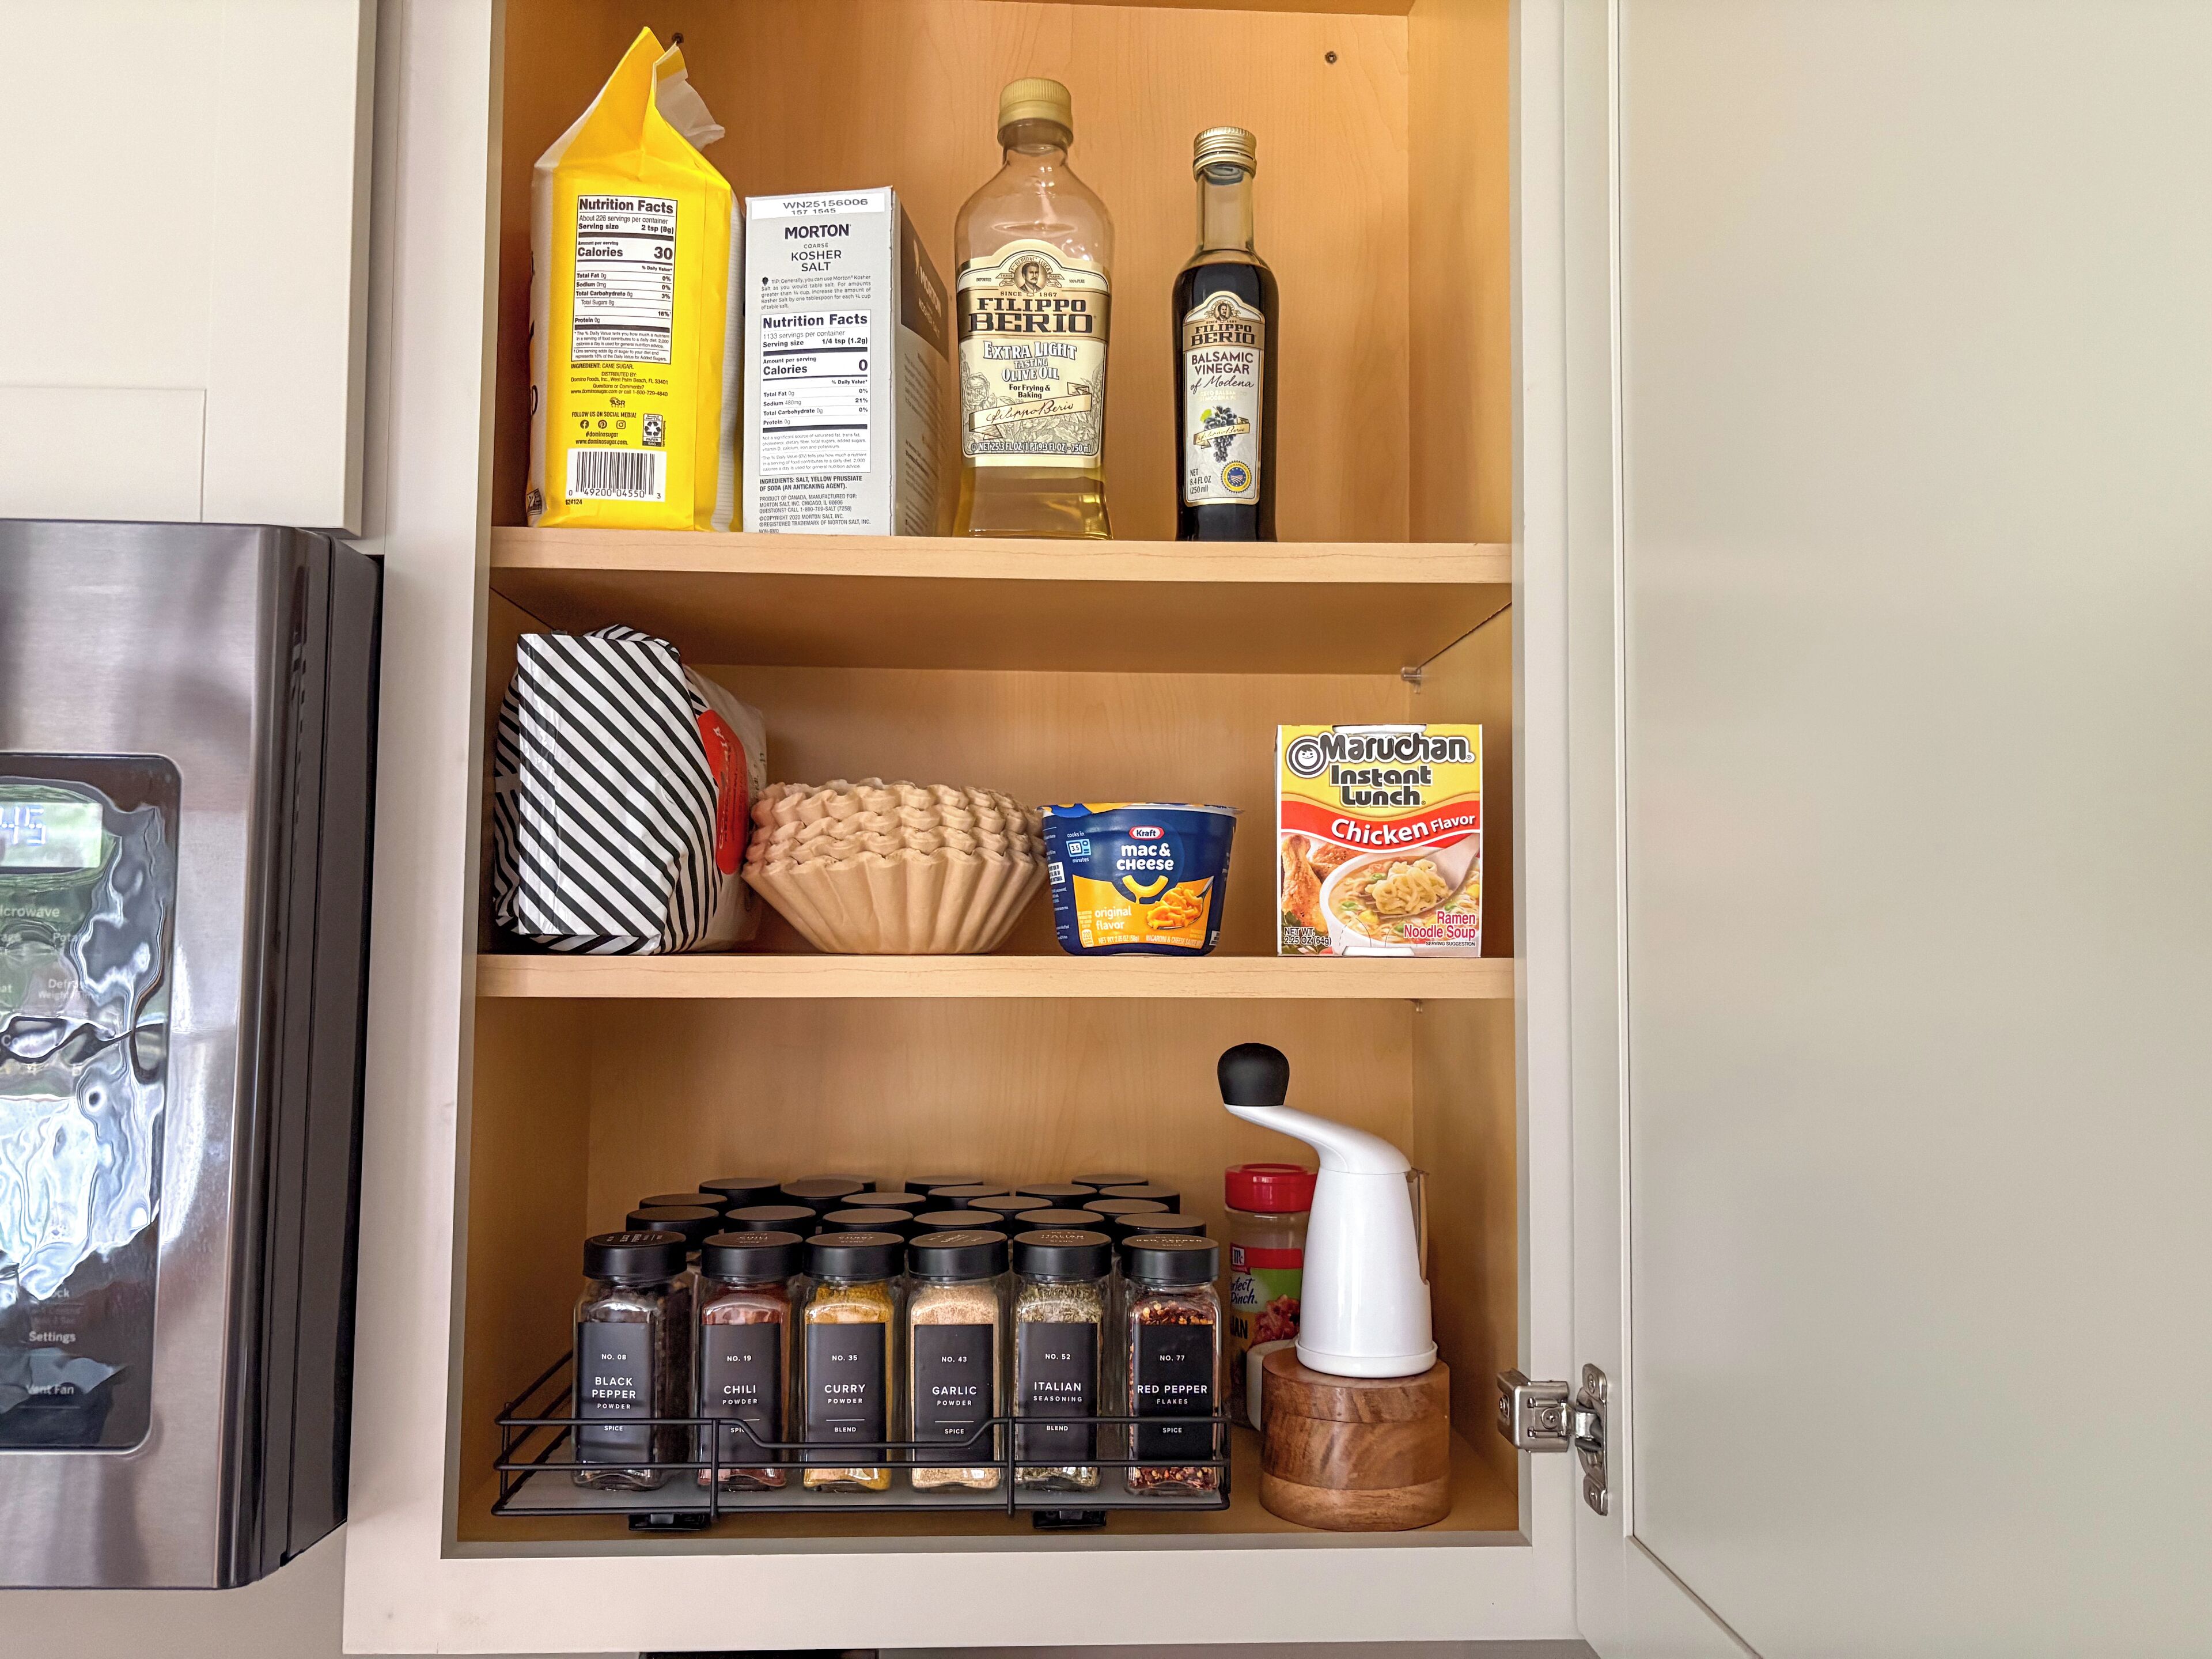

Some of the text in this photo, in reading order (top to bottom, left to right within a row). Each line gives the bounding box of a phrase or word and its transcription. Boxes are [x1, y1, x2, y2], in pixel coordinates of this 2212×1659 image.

[579, 198, 673, 214] Nutrition Facts
[783, 199, 868, 209] WN25156006
[785, 224, 849, 239] MORTON
[578, 247, 673, 259] Calories 30
[791, 250, 842, 261] KOSHER
[802, 262, 831, 271] SALT
[977, 298, 1086, 312] FILIPPO
[763, 314, 868, 328] Nutrition Facts
[968, 313, 1093, 333] BERIO
[1195, 324, 1252, 334] FILIPPO
[1191, 332, 1255, 346] BERIO
[983, 340, 1077, 360] EXTRA LIGHT
[1014, 358, 1048, 369] TASTING
[1192, 351, 1253, 365] BALSAMIC
[763, 359, 868, 375] Calories 0
[1195, 363, 1249, 374] VINEGAR
[1002, 366, 1059, 381] OLIVE OIL
[1191, 375, 1254, 394] of Modena
[1039, 400, 1073, 415] Berio
[979, 442, 990, 452] NET
[991, 443, 1004, 451] 25.3
[1006, 443, 1012, 451] FL
[1013, 443, 1022, 451] OZ
[1030, 443, 1037, 451] PT
[1038, 444, 1048, 452] 9.3
[1050, 444, 1056, 452] FL
[584, 488, 612, 497] 49200
[616, 489, 645, 498] 04550
[1320, 733, 1465, 762] Maruchan
[1332, 765, 1431, 787] Instant
[1342, 786, 1420, 805] Lunch
[1331, 815, 1475, 845] Chicken Flavor
[1121, 843, 1171, 857] mac &
[1095, 906, 1131, 919] original
[1437, 911, 1475, 924] Ramen
[1096, 921, 1125, 930] flavor
[1404, 925, 1476, 940] Noodle Soup
[1314, 937, 1332, 946] (64g)
[29, 1331, 76, 1343] Settings
[595, 1377, 633, 1386] BLACK
[1034, 1381, 1082, 1392] ITALIAN
[55, 1385, 74, 1395] Fan
[592, 1390, 637, 1399] PEPPER
[724, 1385, 756, 1394] CHILI
[824, 1384, 865, 1393] CURRY
[931, 1386, 977, 1395] GARLIC
[1137, 1385, 1207, 1394] RED PEPPER
